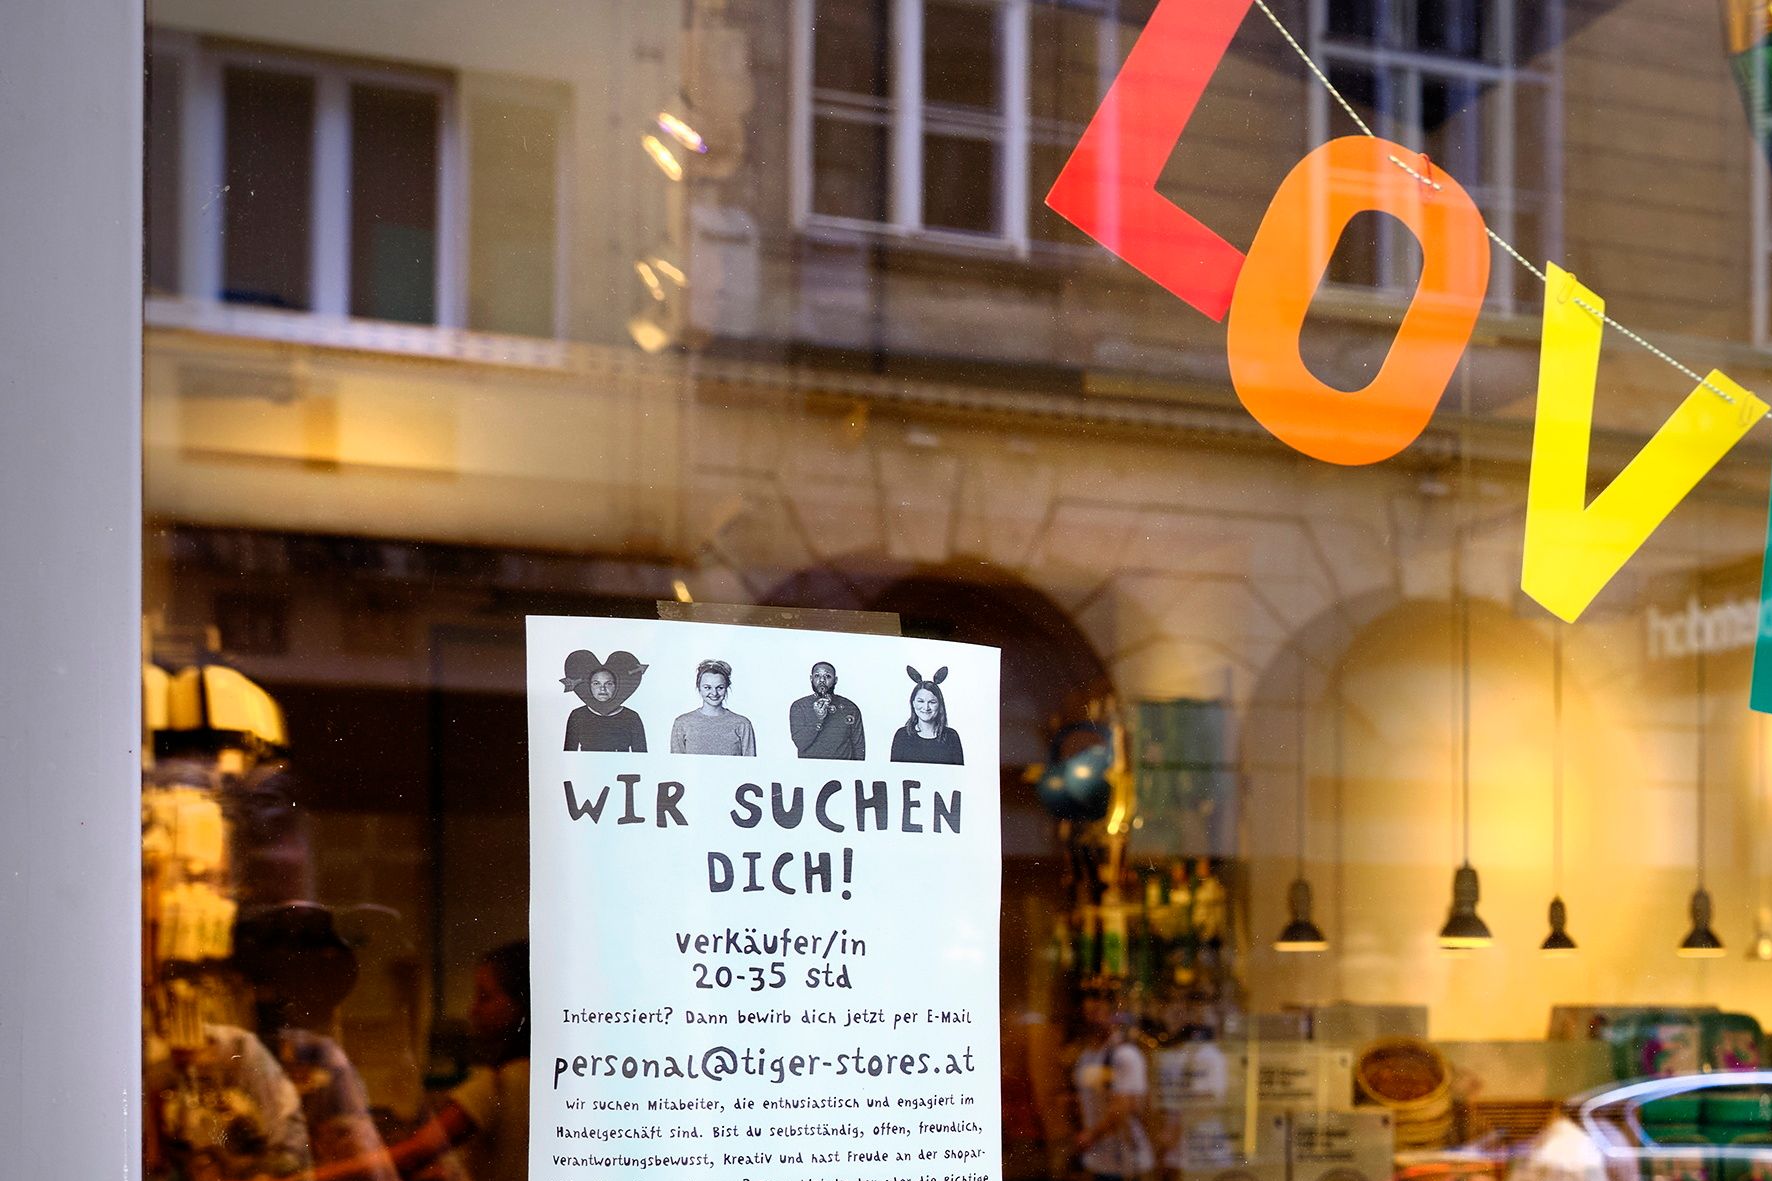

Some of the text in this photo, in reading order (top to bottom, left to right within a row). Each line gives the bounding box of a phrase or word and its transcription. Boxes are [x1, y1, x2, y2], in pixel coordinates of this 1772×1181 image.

[562, 773, 962, 835] WIR SUCHEN
[707, 846, 854, 901] DICH!
[692, 961, 853, 993] 20-35 std
[562, 1006, 972, 1031] Interessiert? Dann bewirb dich jetzt per E-Mail
[553, 1045, 975, 1091] personal@tiger-stores.at
[592, 1100, 640, 1112] suchen
[733, 1097, 755, 1111] die
[762, 1096, 860, 1110] enthusiastisch
[866, 1095, 891, 1109] und
[896, 1093, 956, 1111] engagiert
[960, 1096, 975, 1106] im
[669, 1125, 704, 1139] sind.
[712, 1124, 740, 1139] Bist
[745, 1125, 762, 1138] du
[872, 1121, 911, 1138] offen,
[779, 1151, 804, 1165] und
[811, 1150, 841, 1164] hast
[895, 1151, 912, 1162] an
[917, 1148, 938, 1161] der
